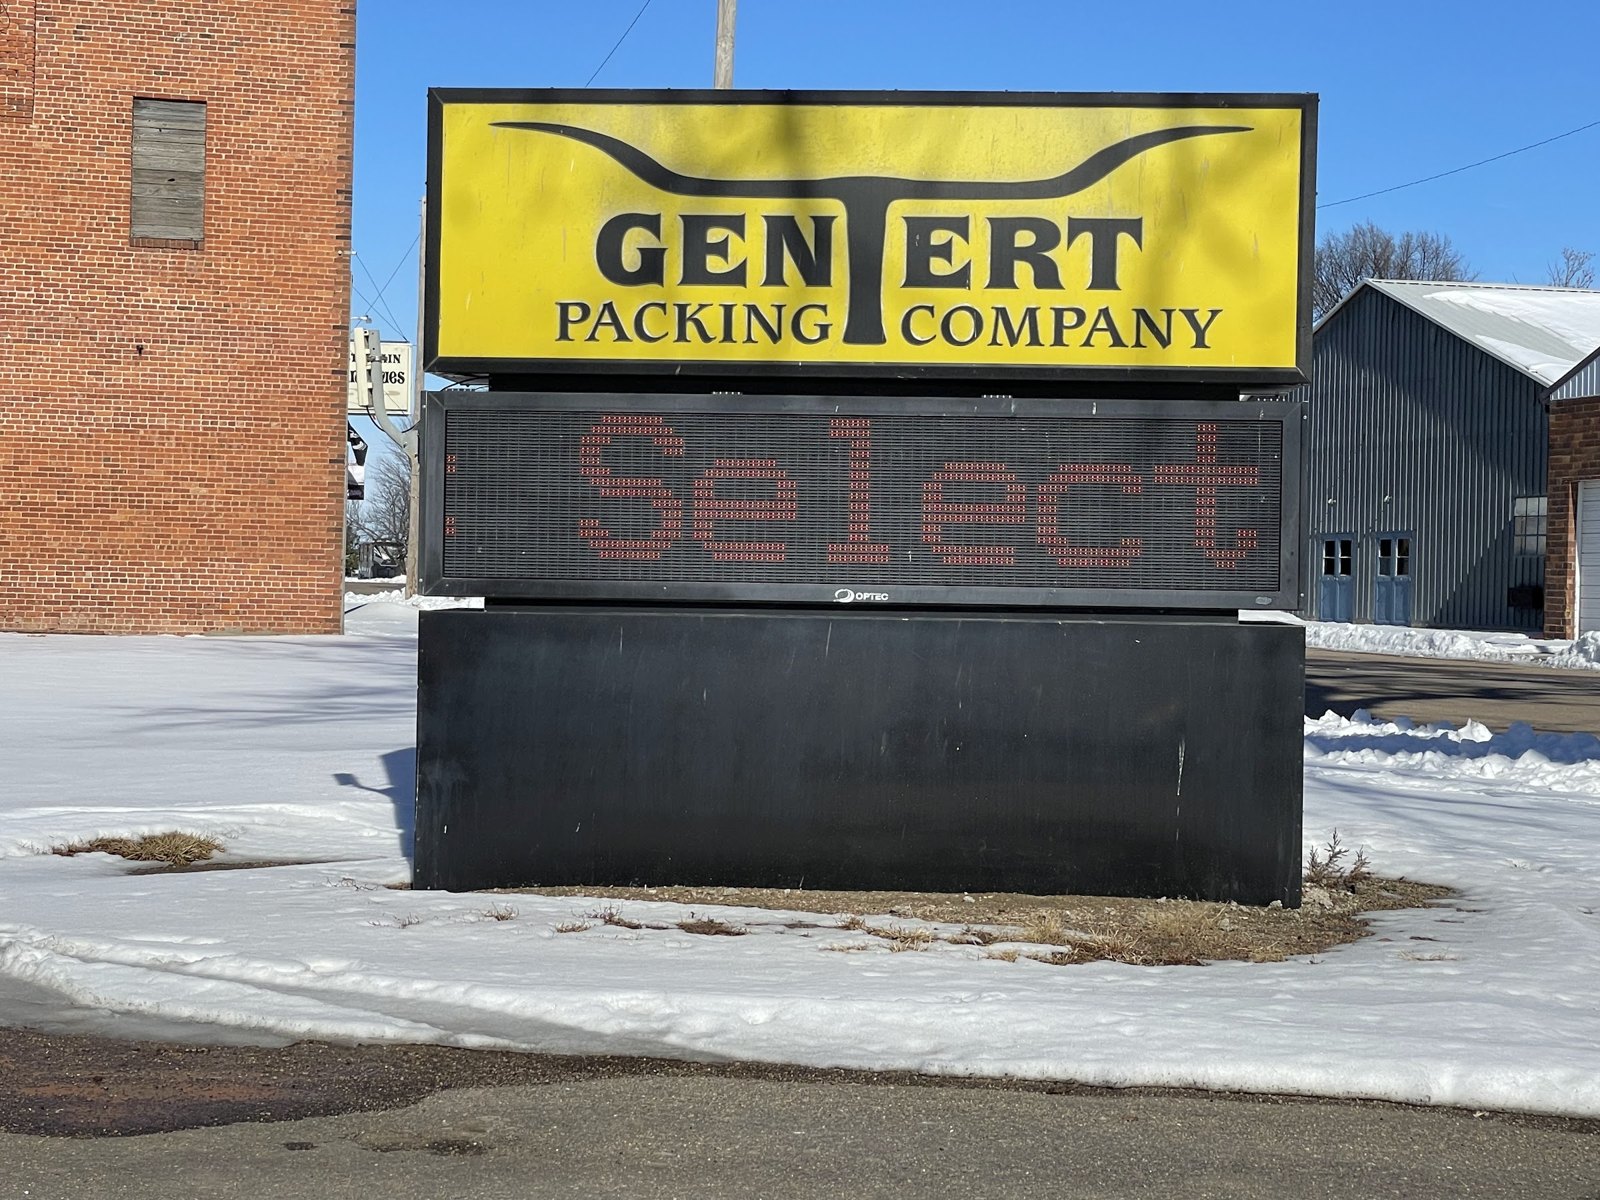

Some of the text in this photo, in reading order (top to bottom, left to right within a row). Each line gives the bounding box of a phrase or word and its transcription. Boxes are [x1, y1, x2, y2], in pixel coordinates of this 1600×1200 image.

[596, 178, 1142, 344] GENTERT
[557, 301, 1222, 349] PACKING COMPANY
[579, 415, 1258, 568] Select
[855, 591, 889, 601] OPTEC
